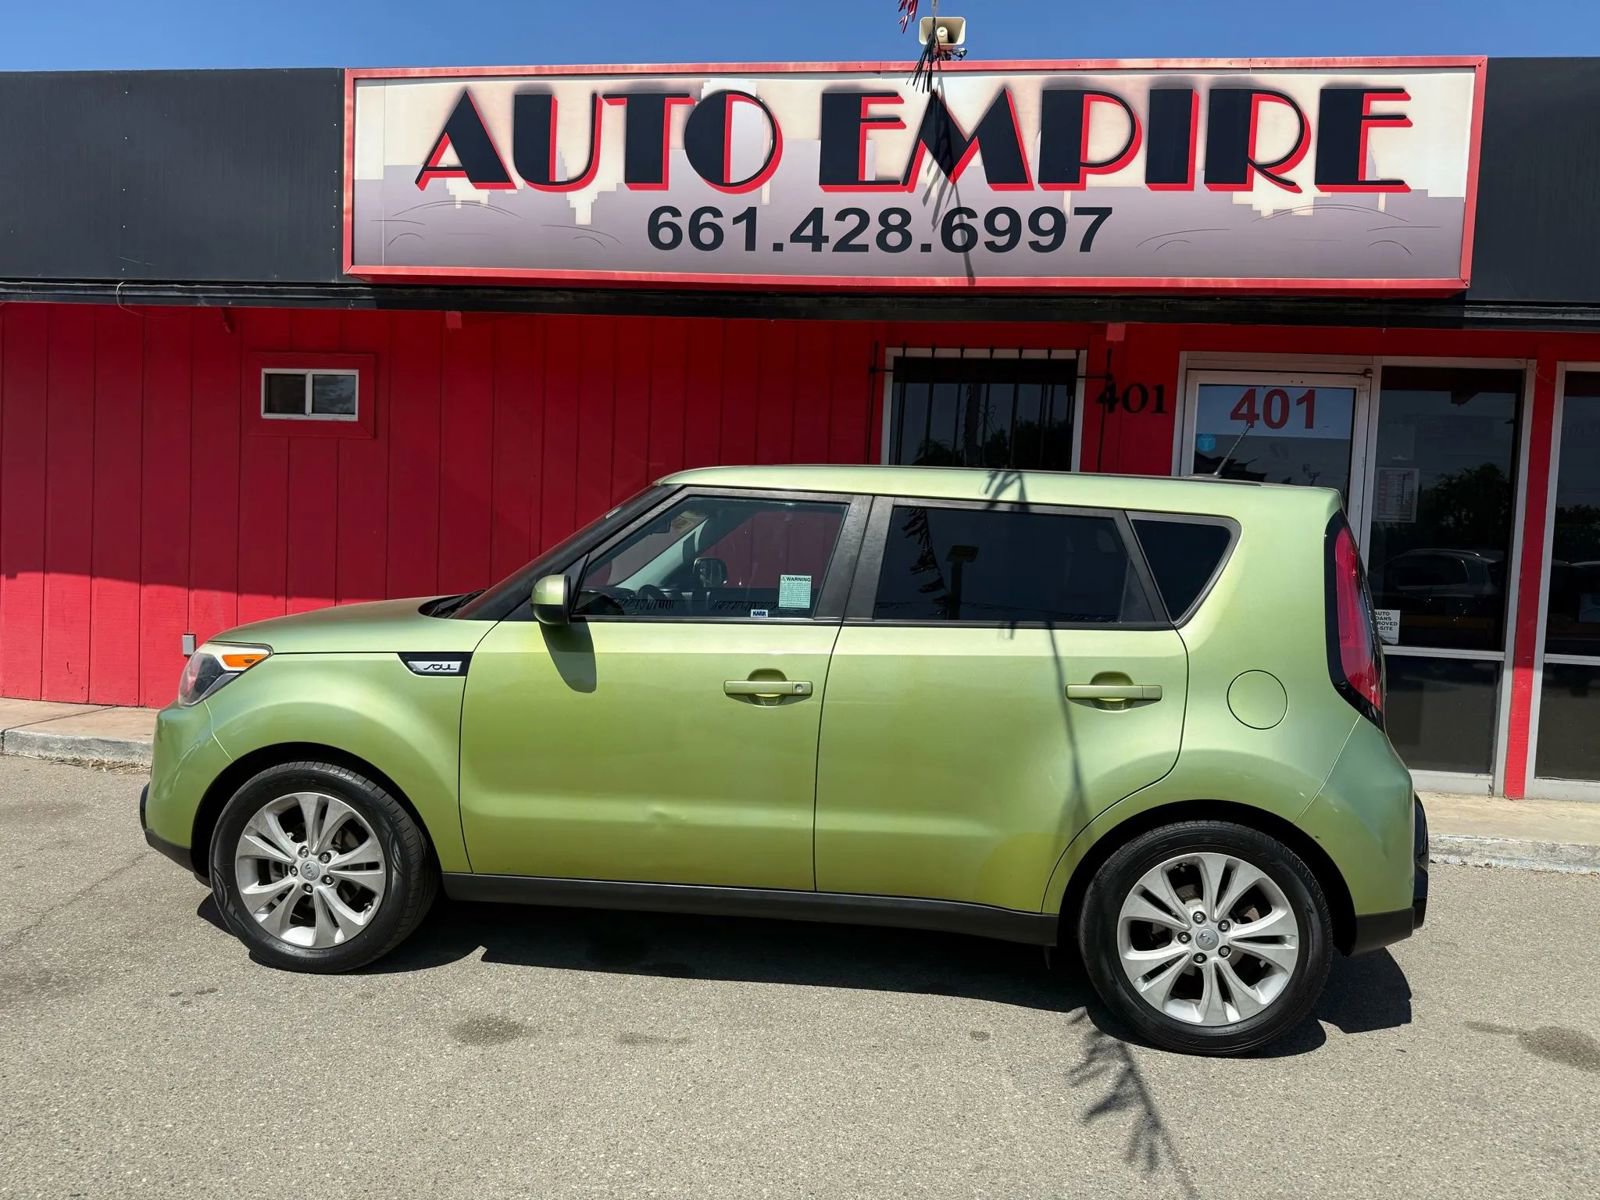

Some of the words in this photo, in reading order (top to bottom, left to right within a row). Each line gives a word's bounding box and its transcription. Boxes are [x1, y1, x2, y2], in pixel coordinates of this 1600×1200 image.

[415, 88, 783, 194] AUTO
[819, 86, 1412, 193] EMPIRE
[647, 205, 1113, 253] 661.428.6997
[1096, 383, 1167, 414] 401
[1230, 387, 1316, 430] 401
